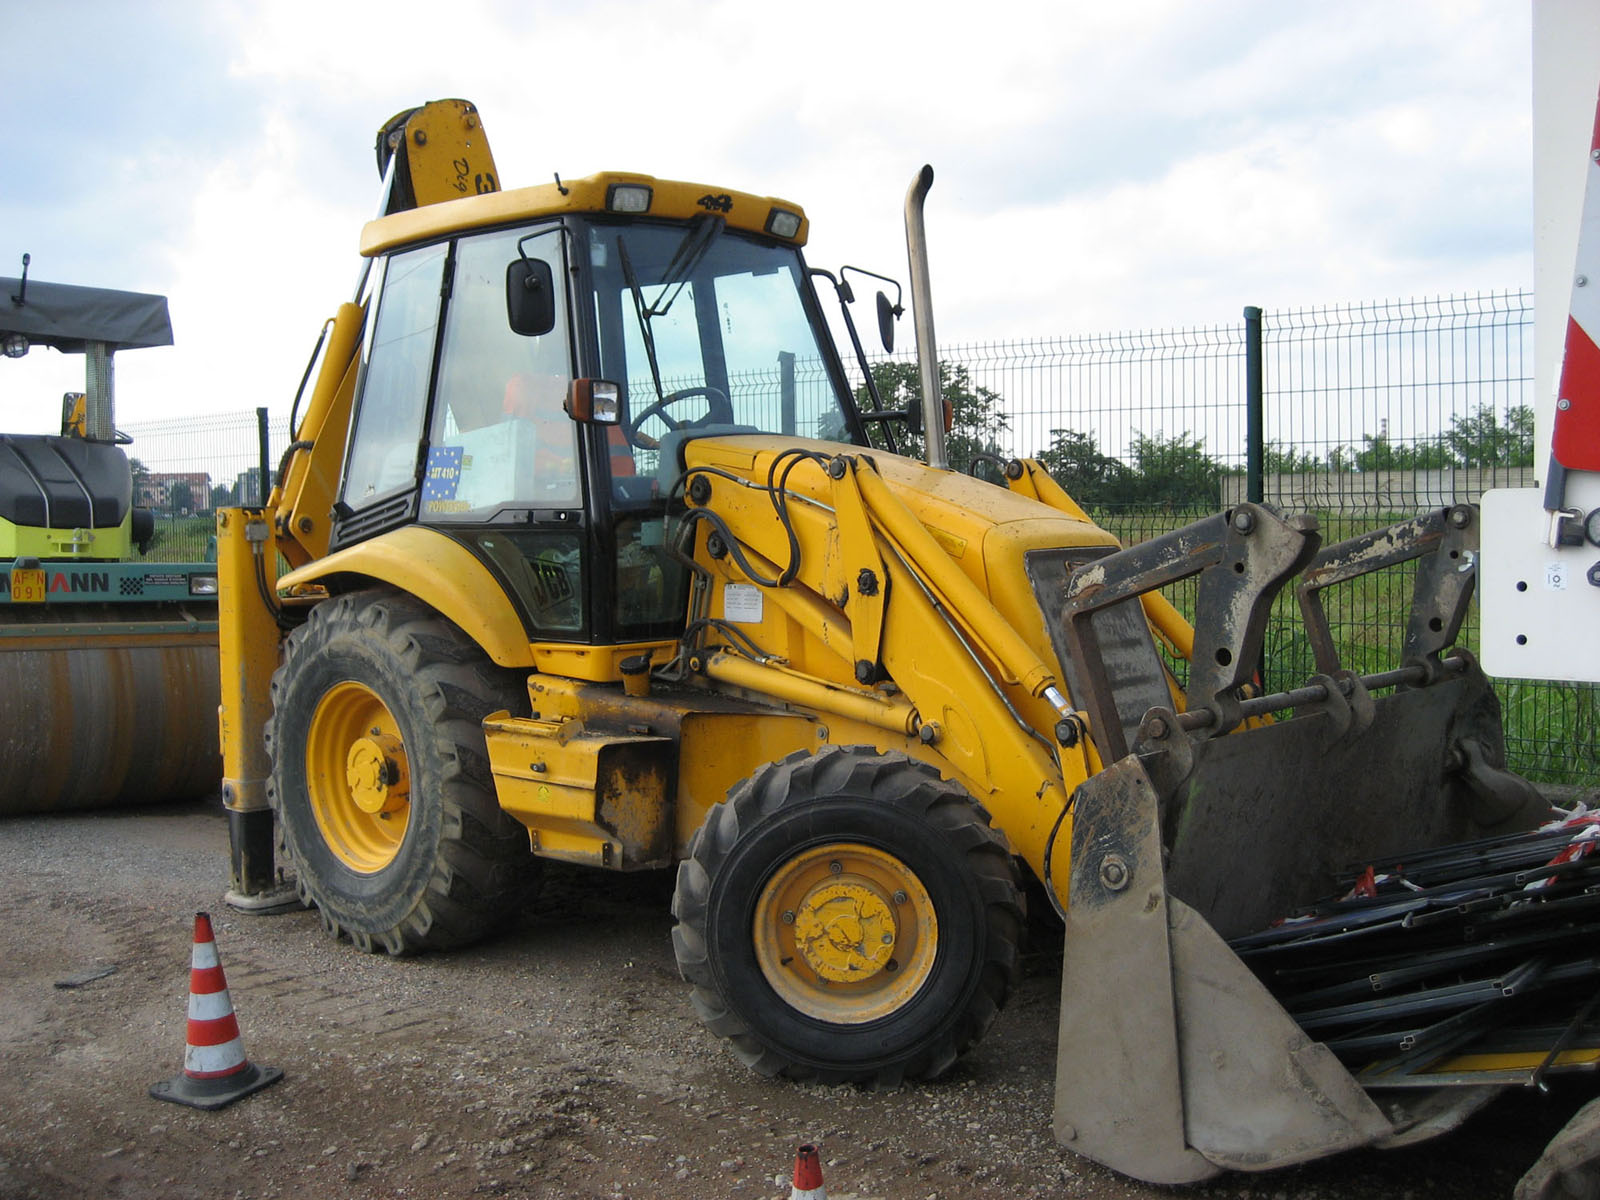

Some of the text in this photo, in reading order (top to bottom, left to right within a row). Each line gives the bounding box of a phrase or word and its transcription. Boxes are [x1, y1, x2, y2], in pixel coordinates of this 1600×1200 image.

[453, 157, 469, 192] Dig
[441, 467, 455, 479] 410
[14, 586, 43, 600] 091
